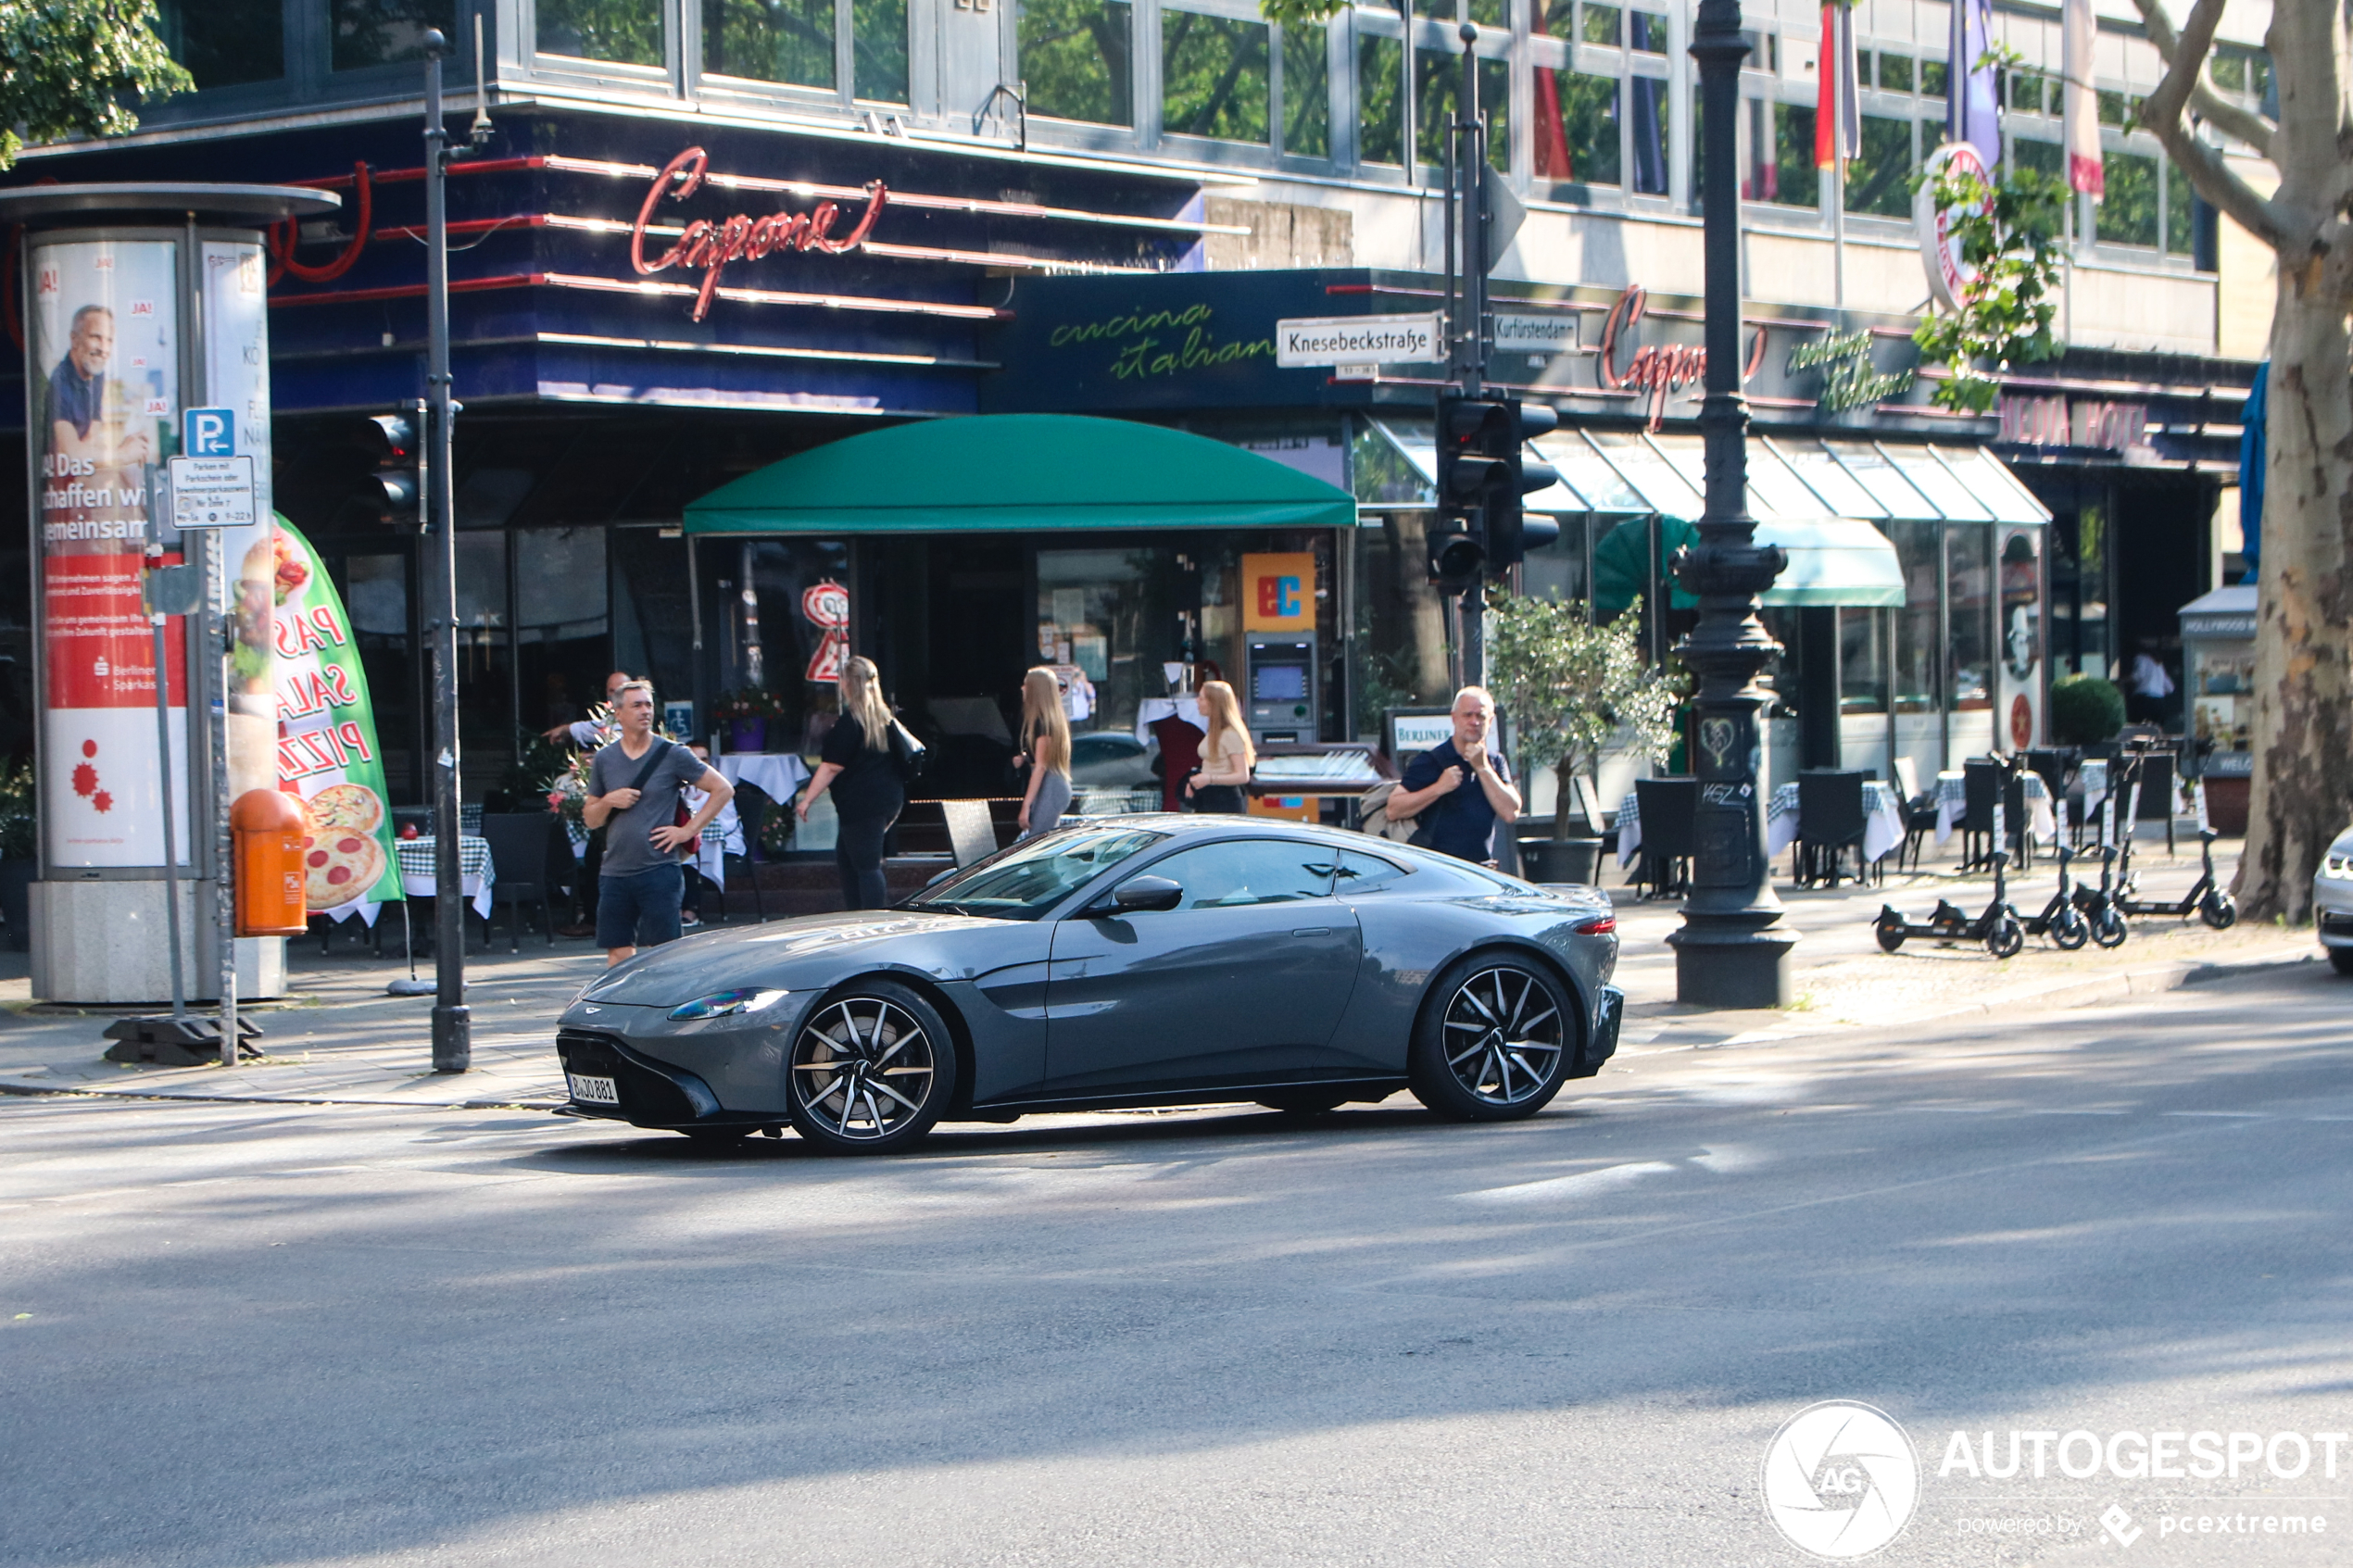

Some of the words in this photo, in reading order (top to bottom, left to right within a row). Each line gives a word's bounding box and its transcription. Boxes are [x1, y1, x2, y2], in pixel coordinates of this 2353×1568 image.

[631, 145, 887, 323] Capone
[132, 303, 152, 314] JA!
[1051, 304, 1212, 346] cucina
[1495, 317, 1574, 340] Kurfürstendamm
[1289, 328, 1428, 354] Knesebeckstraße
[1597, 282, 1768, 434] Capo
[146, 402, 167, 413] JA!
[1999, 395, 2070, 447] MEDIA
[196, 414, 224, 453] P
[57, 454, 94, 477] Das
[43, 483, 112, 509] chaffen
[2185, 620, 2246, 632] HOLLYWOOD
[113, 666, 156, 675] Berliner
[113, 680, 169, 691] Sparkas
[595, 1079, 614, 1100] 881
